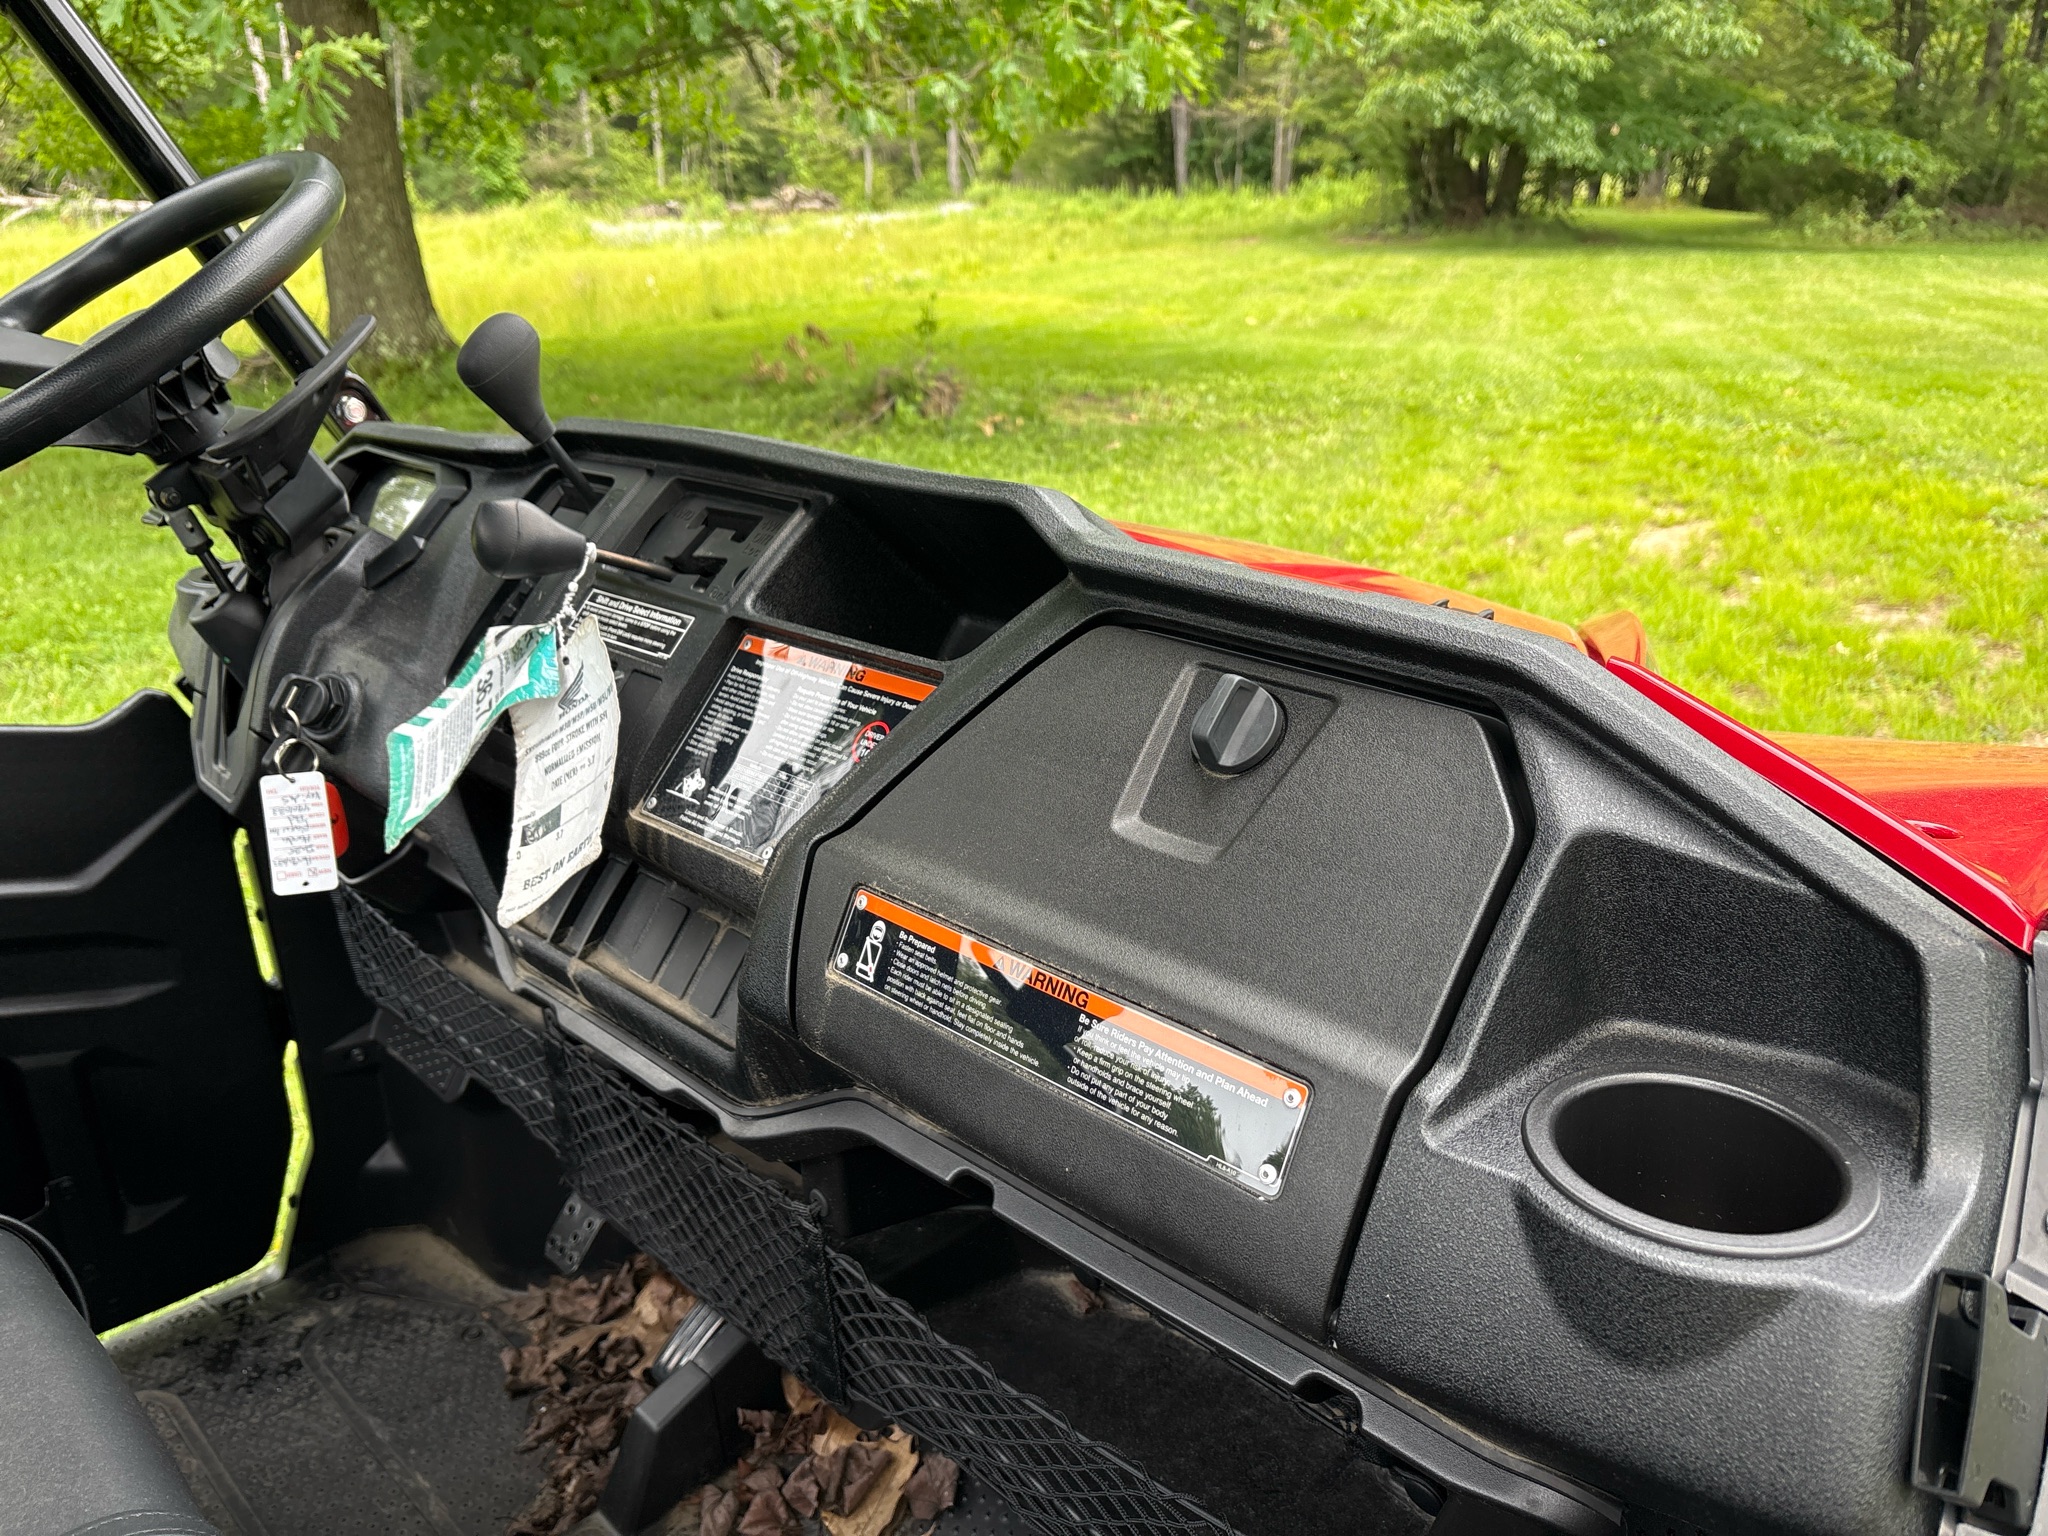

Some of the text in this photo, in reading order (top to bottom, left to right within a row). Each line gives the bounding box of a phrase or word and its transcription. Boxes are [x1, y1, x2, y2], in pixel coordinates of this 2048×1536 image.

[608, 598, 619, 608] and
[619, 600, 632, 613] Drive
[632, 605, 650, 617] Select
[649, 610, 682, 626] Information
[807, 656, 866, 682] WARNING
[559, 693, 589, 720] HONDA
[848, 685, 863, 696] Cause
[863, 689, 880, 700] Severe
[880, 694, 895, 706] Injury
[523, 867, 551, 890] BEST
[553, 856, 565, 874] ON
[899, 931, 936, 954] Be Prepared
[899, 941, 914, 953] Fasten
[890, 967, 902, 976] Each
[902, 973, 912, 981] rider
[913, 978, 925, 987] must
[932, 988, 942, 996] able
[965, 1004, 993, 1023] designated
[994, 1018, 1013, 1033] seating
[893, 958, 906, 968] Close
[906, 965, 919, 975] doors
[929, 976, 941, 986] latch
[942, 983, 952, 991] nets
[953, 987, 968, 999] before
[896, 950, 908, 959] Wear
[915, 959, 936, 974] approved
[937, 970, 953, 981] helmet
[954, 978, 963, 986] and
[964, 984, 988, 999] protective
[988, 996, 1002, 1007] gear.
[1009, 959, 1089, 1009] WARNING
[887, 975, 904, 988] position
[905, 984, 914, 992] with
[915, 989, 926, 998] back
[926, 995, 944, 1009] against
[957, 1010, 967, 1019] feet
[967, 1015, 976, 1023] flat
[984, 1023, 995, 1033] floor
[996, 1029, 1006, 1039] and
[1007, 1035, 1024, 1048] hands
[891, 986, 909, 1001] steering
[909, 996, 923, 1007] wheel
[953, 1018, 965, 1030] Stay
[965, 1025, 993, 1044] completely
[993, 1039, 1009, 1050] inside
[1010, 1047, 1019, 1055] the
[1020, 1052, 1040, 1066] vehicle.
[1076, 1047, 1092, 1061] Keep
[1099, 1057, 1111, 1068] firm
[1111, 1064, 1124, 1076] grip
[1125, 1071, 1133, 1079] on
[1134, 1075, 1144, 1084] the
[1146, 1080, 1172, 1099] steering
[1173, 1093, 1193, 1108] wheel
[1079, 1013, 1268, 1106] Be Sure Riders Pay Attention and Plan Ahead
[1082, 1028, 1093, 1039] you
[1095, 1034, 1109, 1045] think
[1118, 1045, 1130, 1054] feel
[1131, 1051, 1142, 1060] the
[1142, 1056, 1165, 1071] vehicle
[1165, 1068, 1180, 1080] may
[1094, 1044, 1114, 1058] reduce
[1115, 1055, 1128, 1067] your
[1131, 1061, 1142, 1071] risk
[1143, 1067, 1150, 1075] of
[1067, 1076, 1088, 1090] outside
[1097, 1090, 1106, 1099] the
[1108, 1096, 1129, 1111] vehicle
[1131, 1107, 1140, 1116] for
[1140, 1113, 1153, 1125] any
[1154, 1120, 1179, 1136] reason.
[1071, 1066, 1168, 1120] Do not put any part of your body
[1081, 1060, 1111, 1080] handholds
[1113, 1075, 1124, 1086] and
[1126, 1082, 1143, 1095] brace
[1145, 1091, 1172, 1110] yourself.
